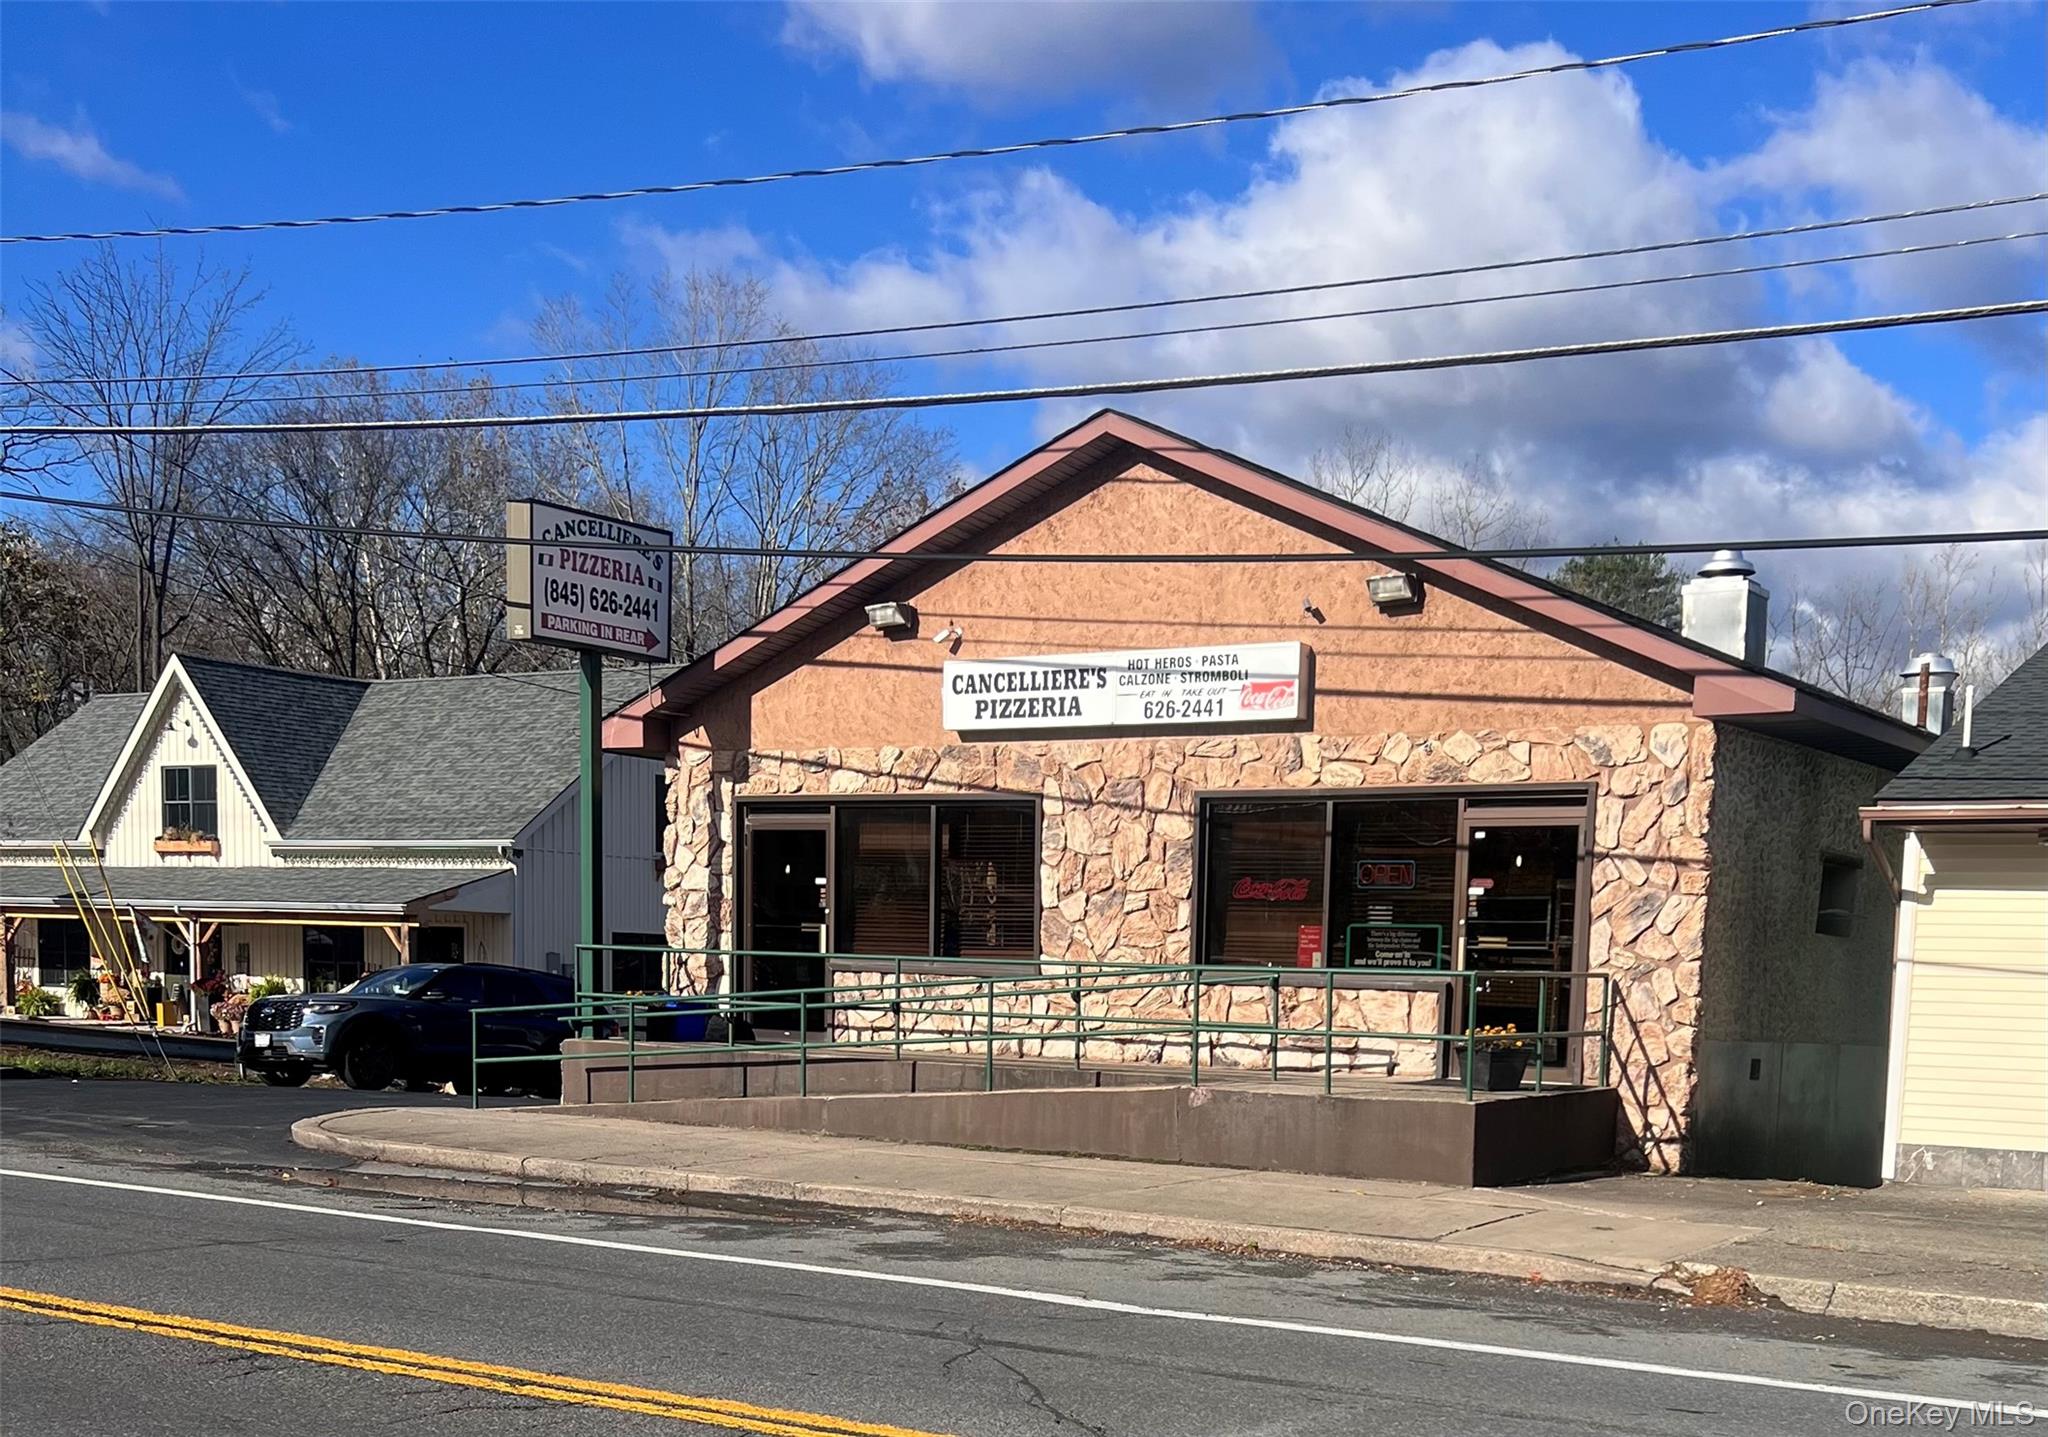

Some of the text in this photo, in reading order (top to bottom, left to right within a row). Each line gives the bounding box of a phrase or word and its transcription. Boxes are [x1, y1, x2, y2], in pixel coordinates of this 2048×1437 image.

[559, 548, 645, 586] PIZZERIA
[544, 577, 659, 622] (845) 626-2441
[547, 615, 645, 646] PARKING IN REAR
[1127, 654, 1239, 671] HOT HEROS PASTA
[952, 667, 1107, 695] CANCELLIERE'S
[1119, 669, 1249, 686] CALZONE STROMBOLI
[1140, 687, 1228, 699] EAT IN TAKE OUT
[974, 696, 1082, 719] PIZZERIA
[1144, 698, 1224, 719] 626-2441
[1360, 864, 1413, 885] OPEN
[1383, 959, 1401, 967] prove
